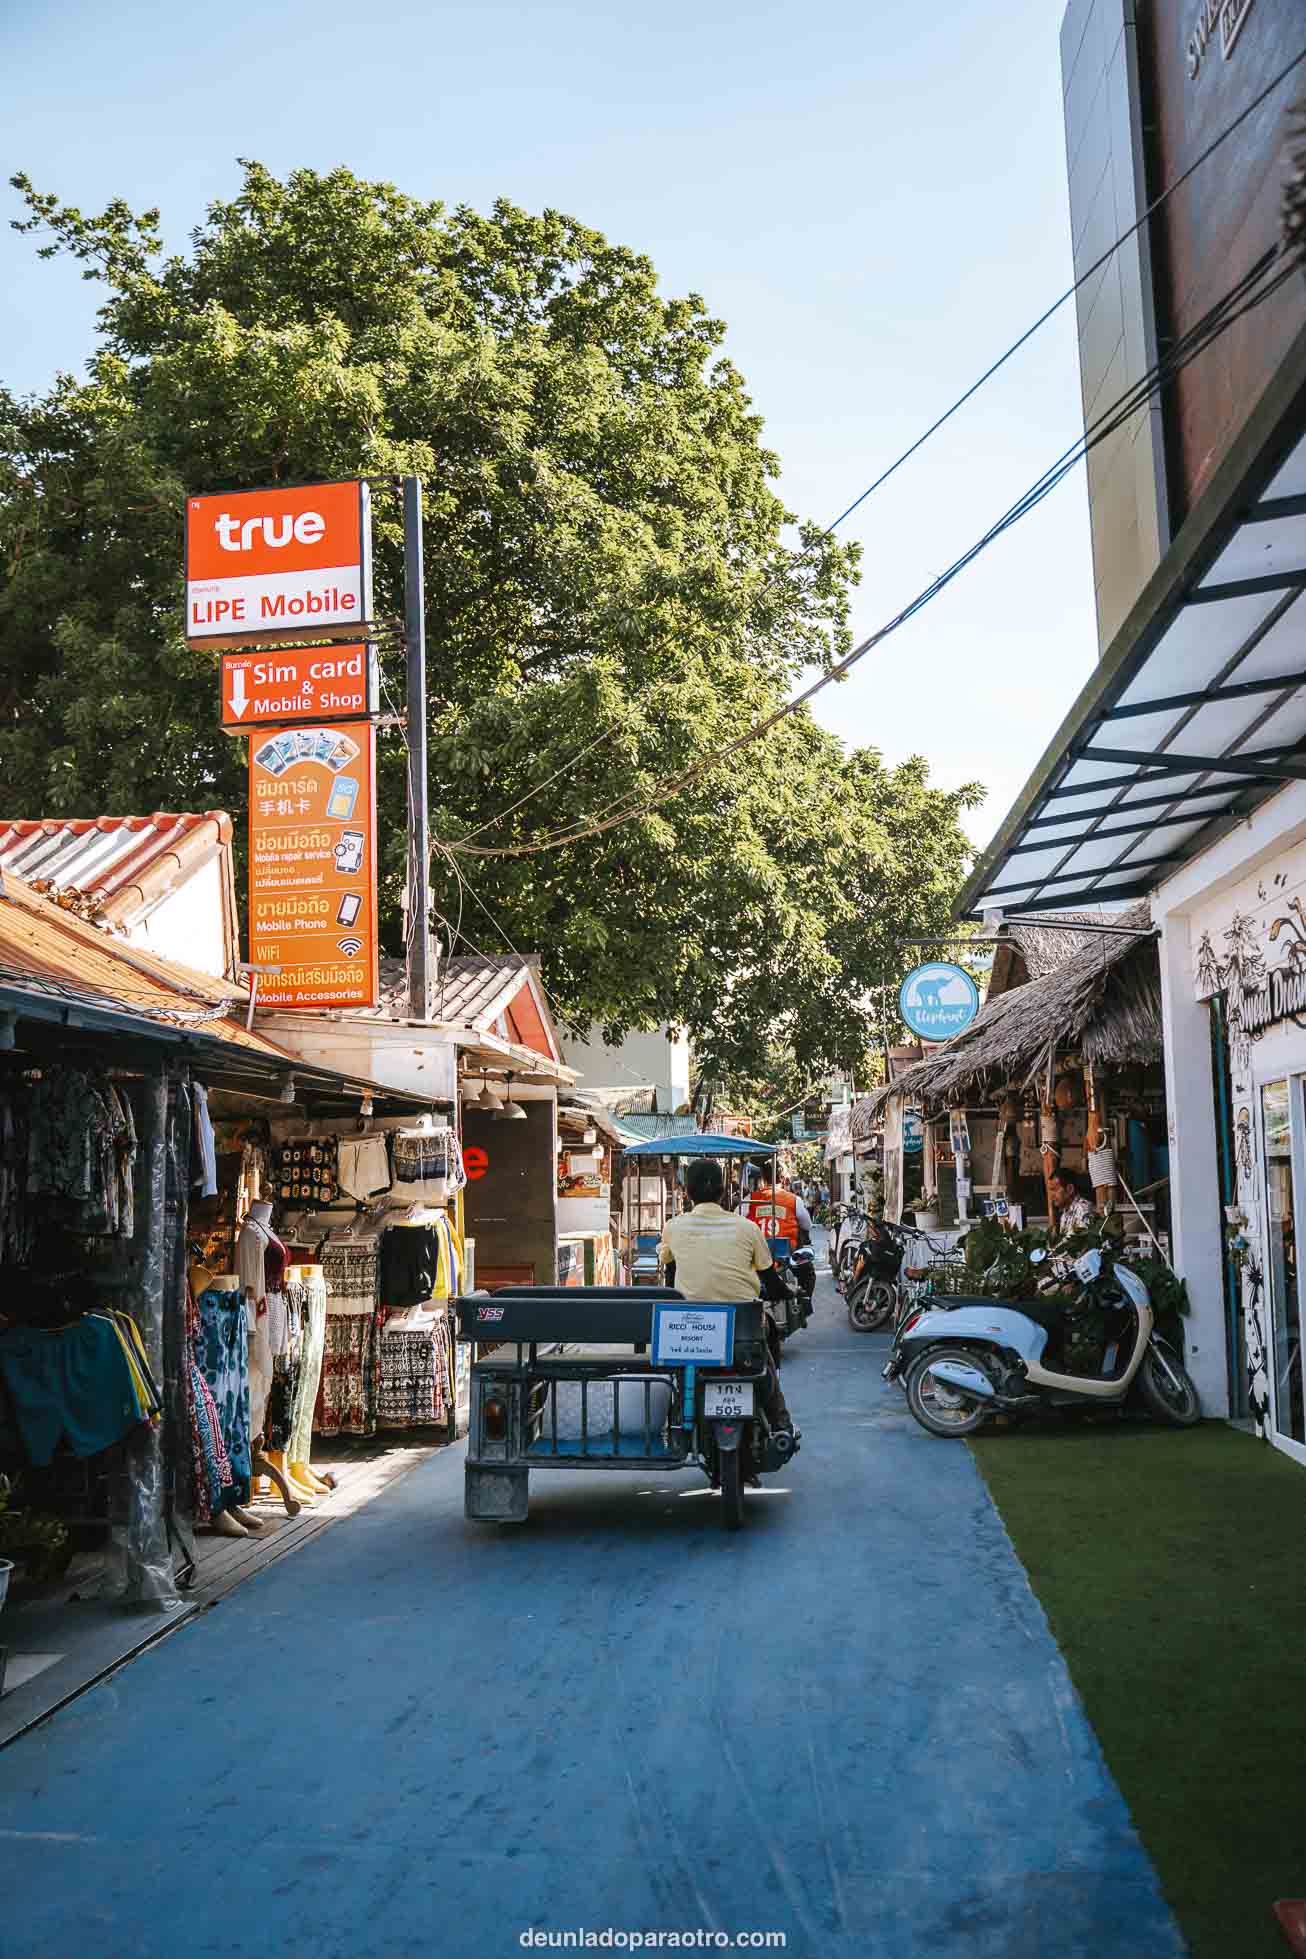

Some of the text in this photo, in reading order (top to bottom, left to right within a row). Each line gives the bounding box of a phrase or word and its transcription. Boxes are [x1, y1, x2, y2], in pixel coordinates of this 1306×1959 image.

[215, 511, 326, 551] true
[192, 588, 356, 624] LIPE Mobile
[253, 662, 297, 684] Sim
[309, 654, 362, 680] card
[301, 680, 315, 695] &
[253, 692, 363, 714] Mobile Shop
[258, 798, 312, 816] 手机卡
[257, 896, 330, 917] ขายมือถือ
[256, 918, 327, 932] Mobile Phone
[256, 988, 363, 1003] Mobile Accessories
[715, 1405, 742, 1415] 505
